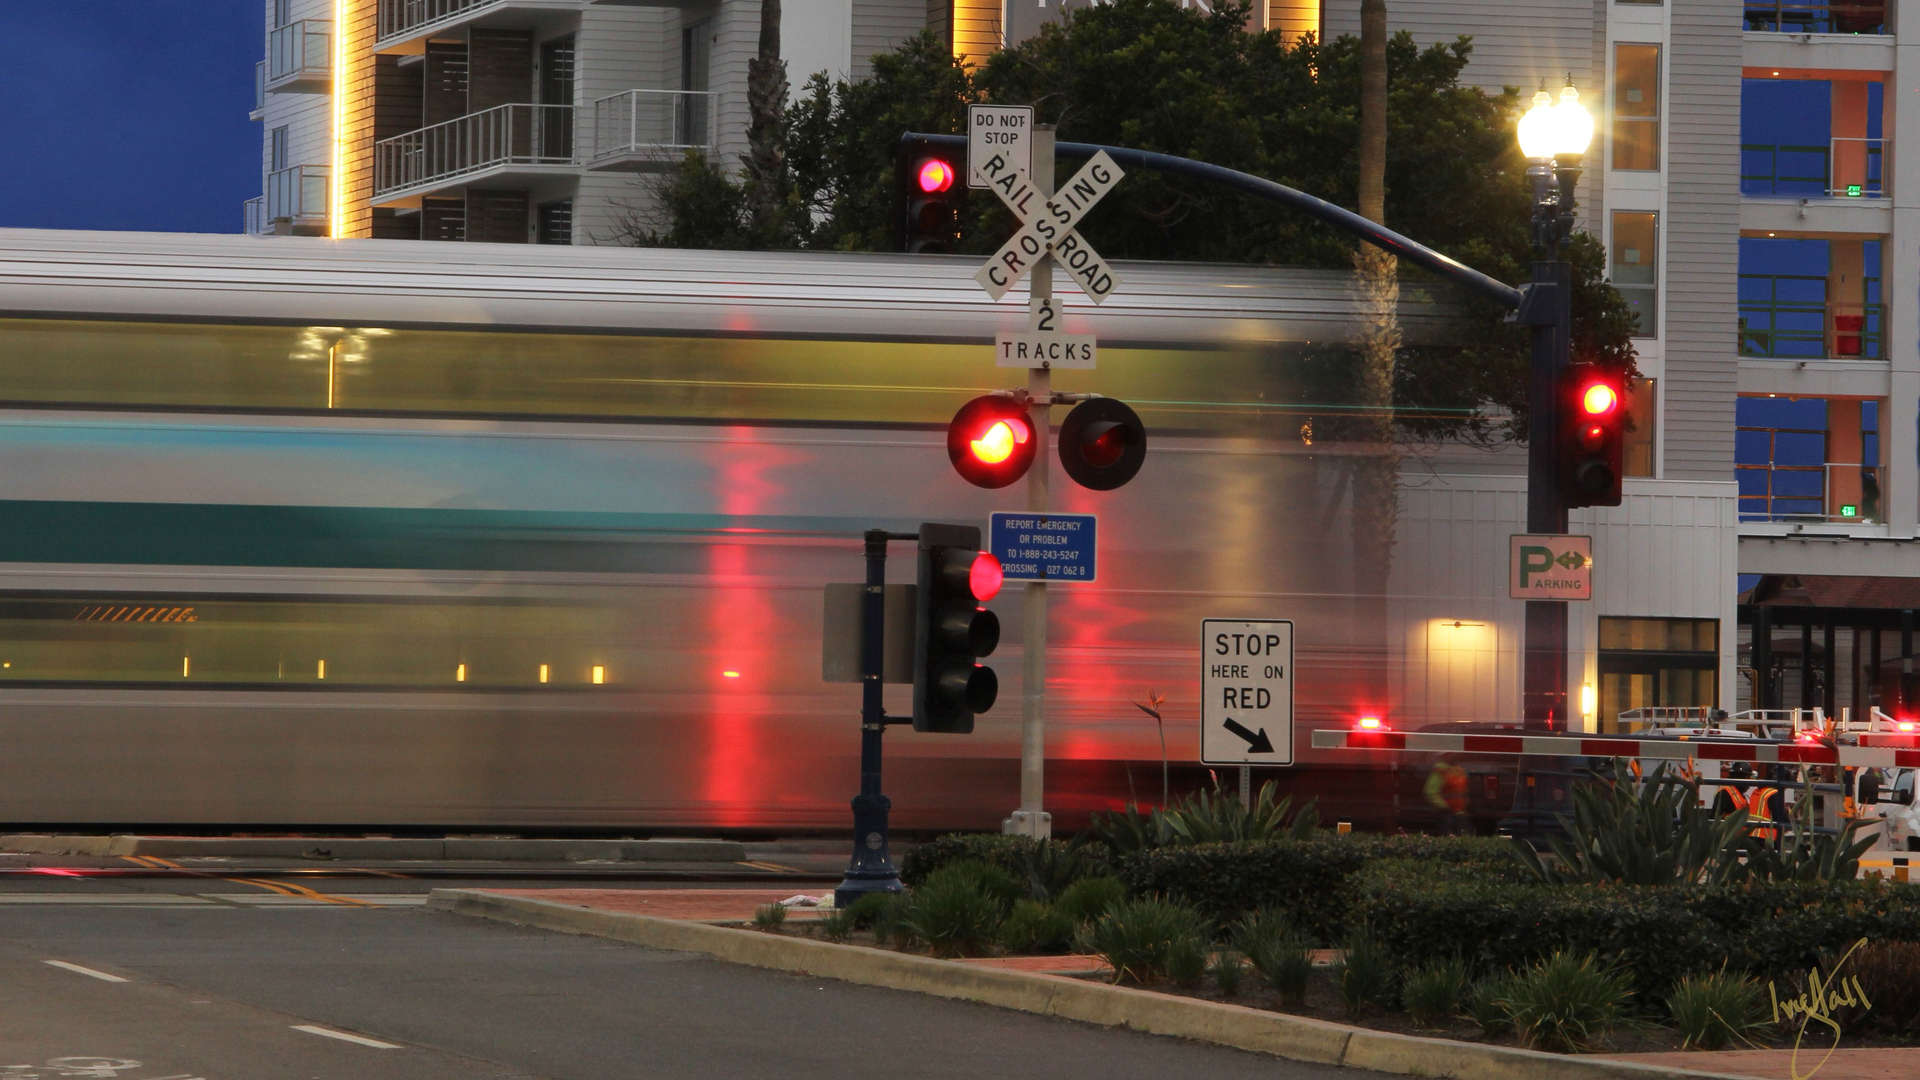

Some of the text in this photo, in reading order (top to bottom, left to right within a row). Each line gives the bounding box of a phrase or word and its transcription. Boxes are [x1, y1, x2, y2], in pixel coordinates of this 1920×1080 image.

[976, 114, 1025, 128] DO NOT
[985, 132, 1018, 145] STOP
[983, 154, 1112, 296] RAIL ROAD
[988, 164, 1111, 287] CROSSING
[1037, 306, 1054, 331] 2
[1002, 341, 1091, 360] TRACKS
[1005, 519, 1081, 531] REPORT EMERGENCY
[1019, 534, 1067, 545] OR PROBLEM
[1007, 548, 1079, 560] TO 1-888-243-5247
[1001, 563, 1085, 576] CROSSING 027 062 B
[1215, 633, 1280, 656] STOP
[1211, 664, 1283, 679] HERE ON
[1223, 687, 1271, 710] RED
